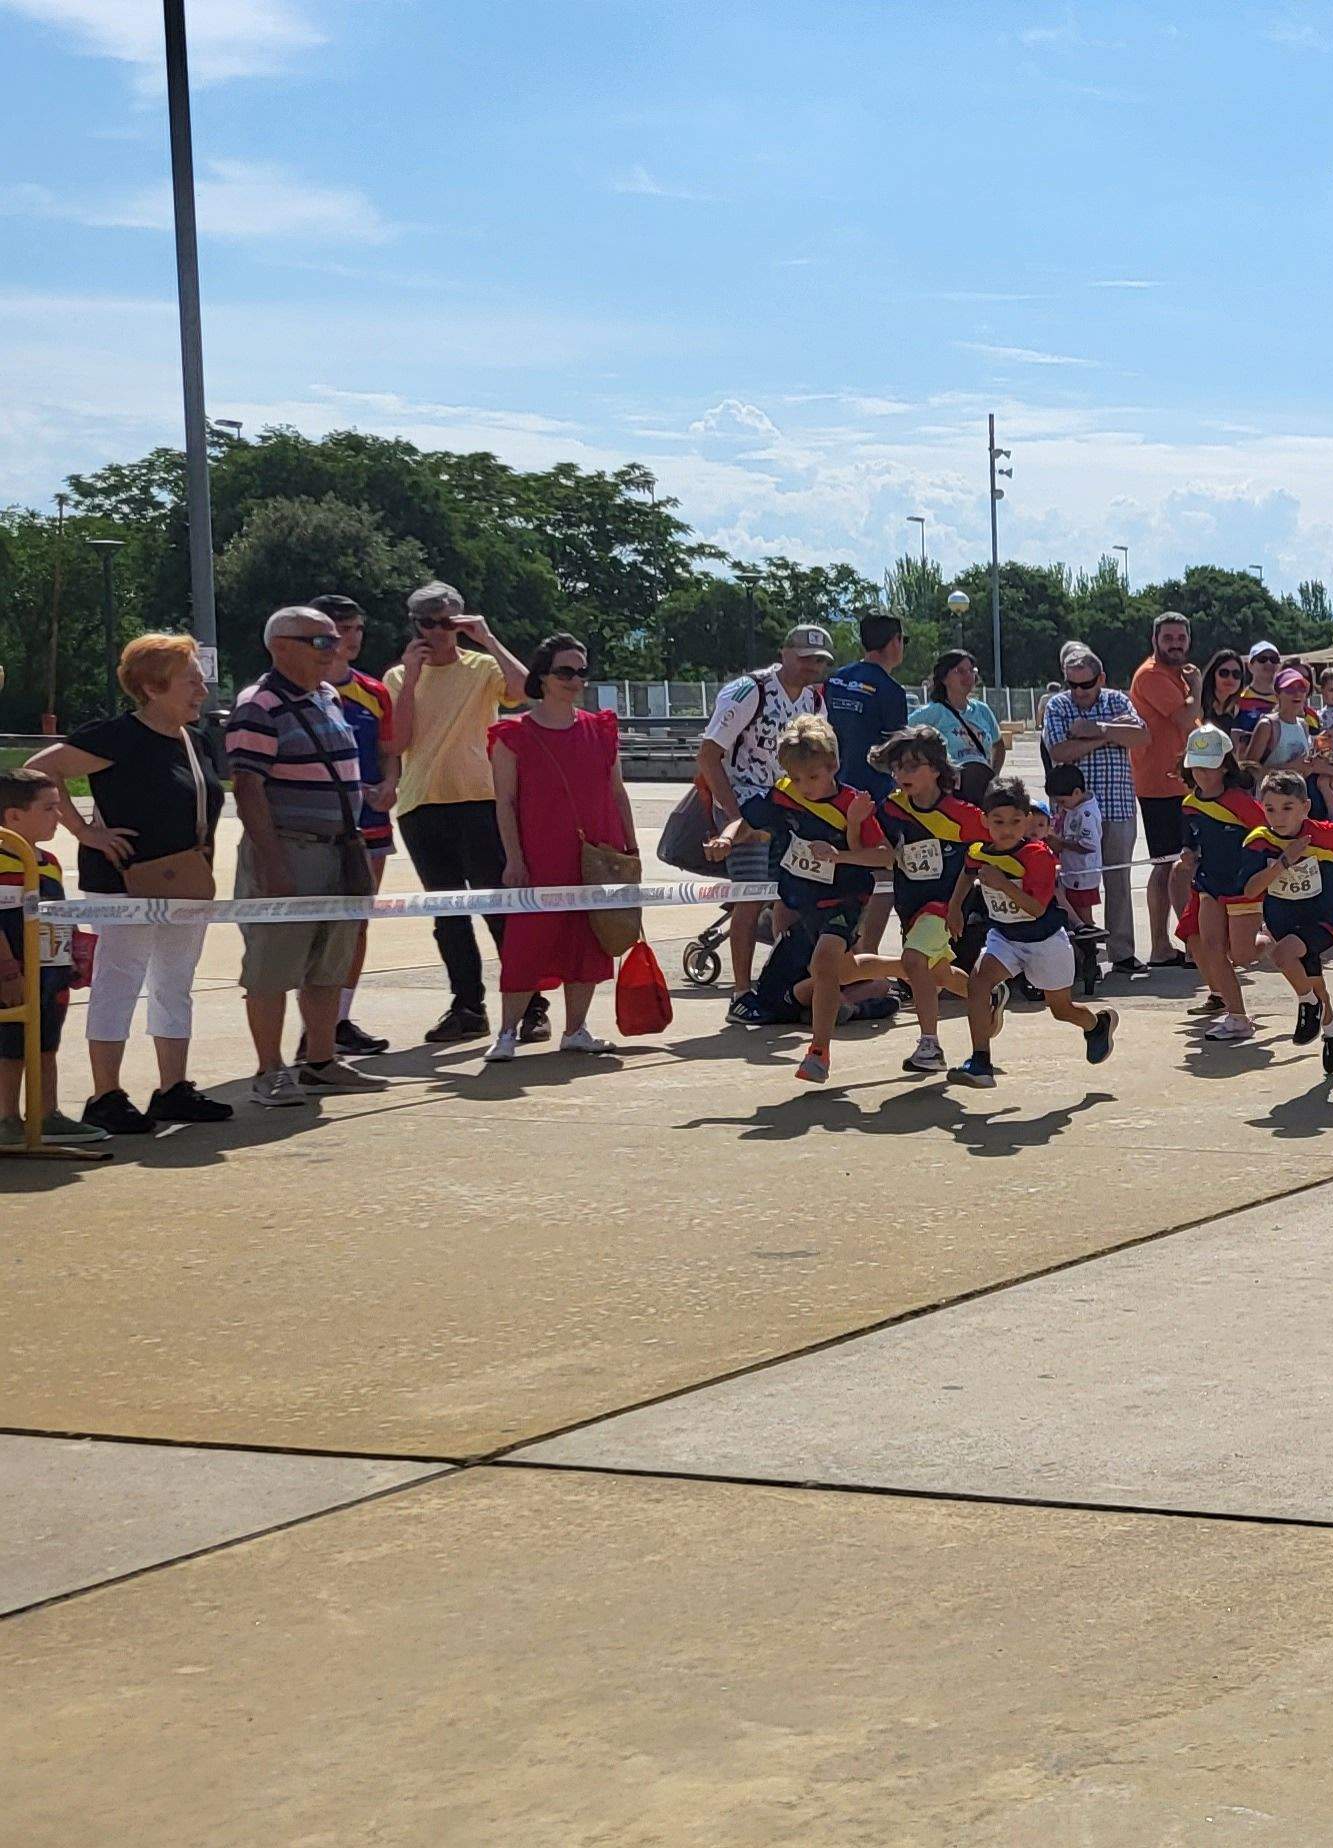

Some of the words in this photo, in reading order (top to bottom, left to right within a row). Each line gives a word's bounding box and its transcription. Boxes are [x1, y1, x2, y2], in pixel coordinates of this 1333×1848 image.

[791, 854, 821, 874] 702
[906, 859, 931, 874] 34
[1279, 879, 1312, 894] 768
[990, 899, 1020, 915] 849
